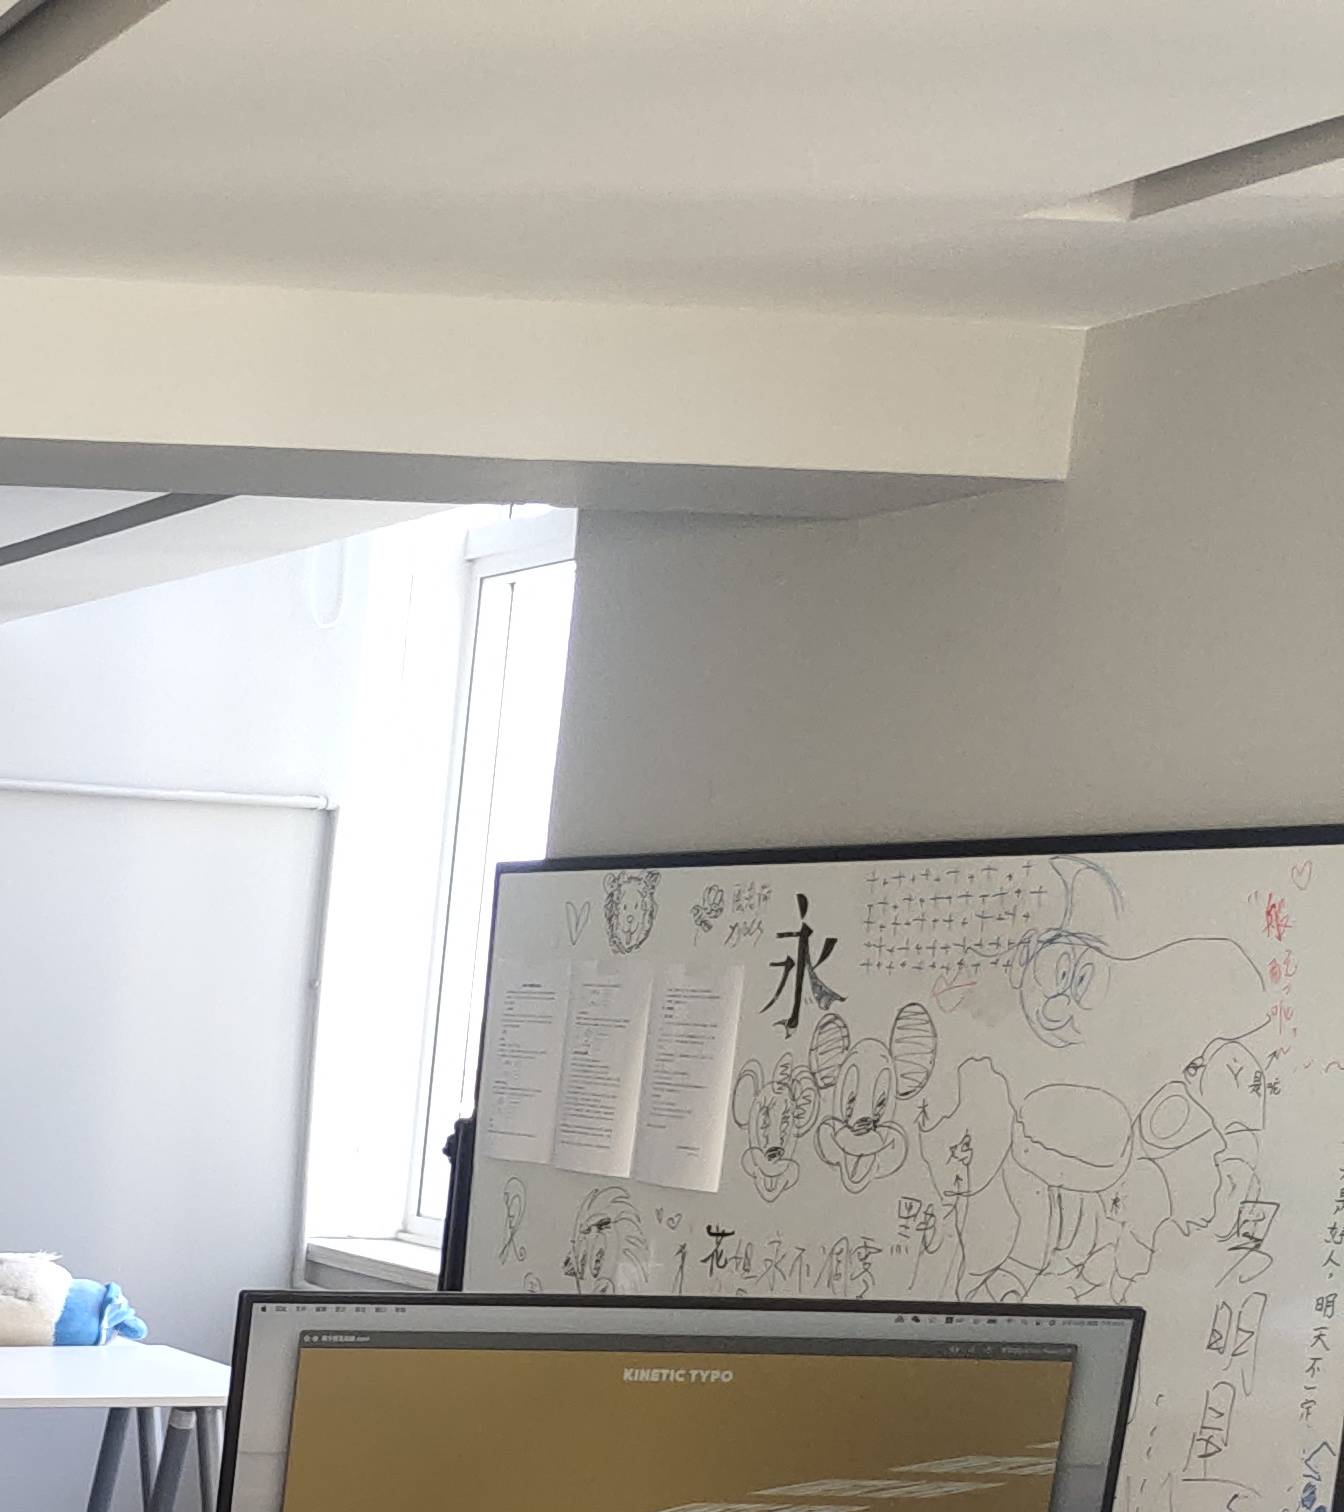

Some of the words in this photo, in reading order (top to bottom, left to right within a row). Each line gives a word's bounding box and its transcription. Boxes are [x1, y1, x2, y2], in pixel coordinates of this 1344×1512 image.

[759, 893, 846, 1038] 永
[623, 1368, 686, 1382] KINETIC
[688, 1369, 734, 1383] TYPO
